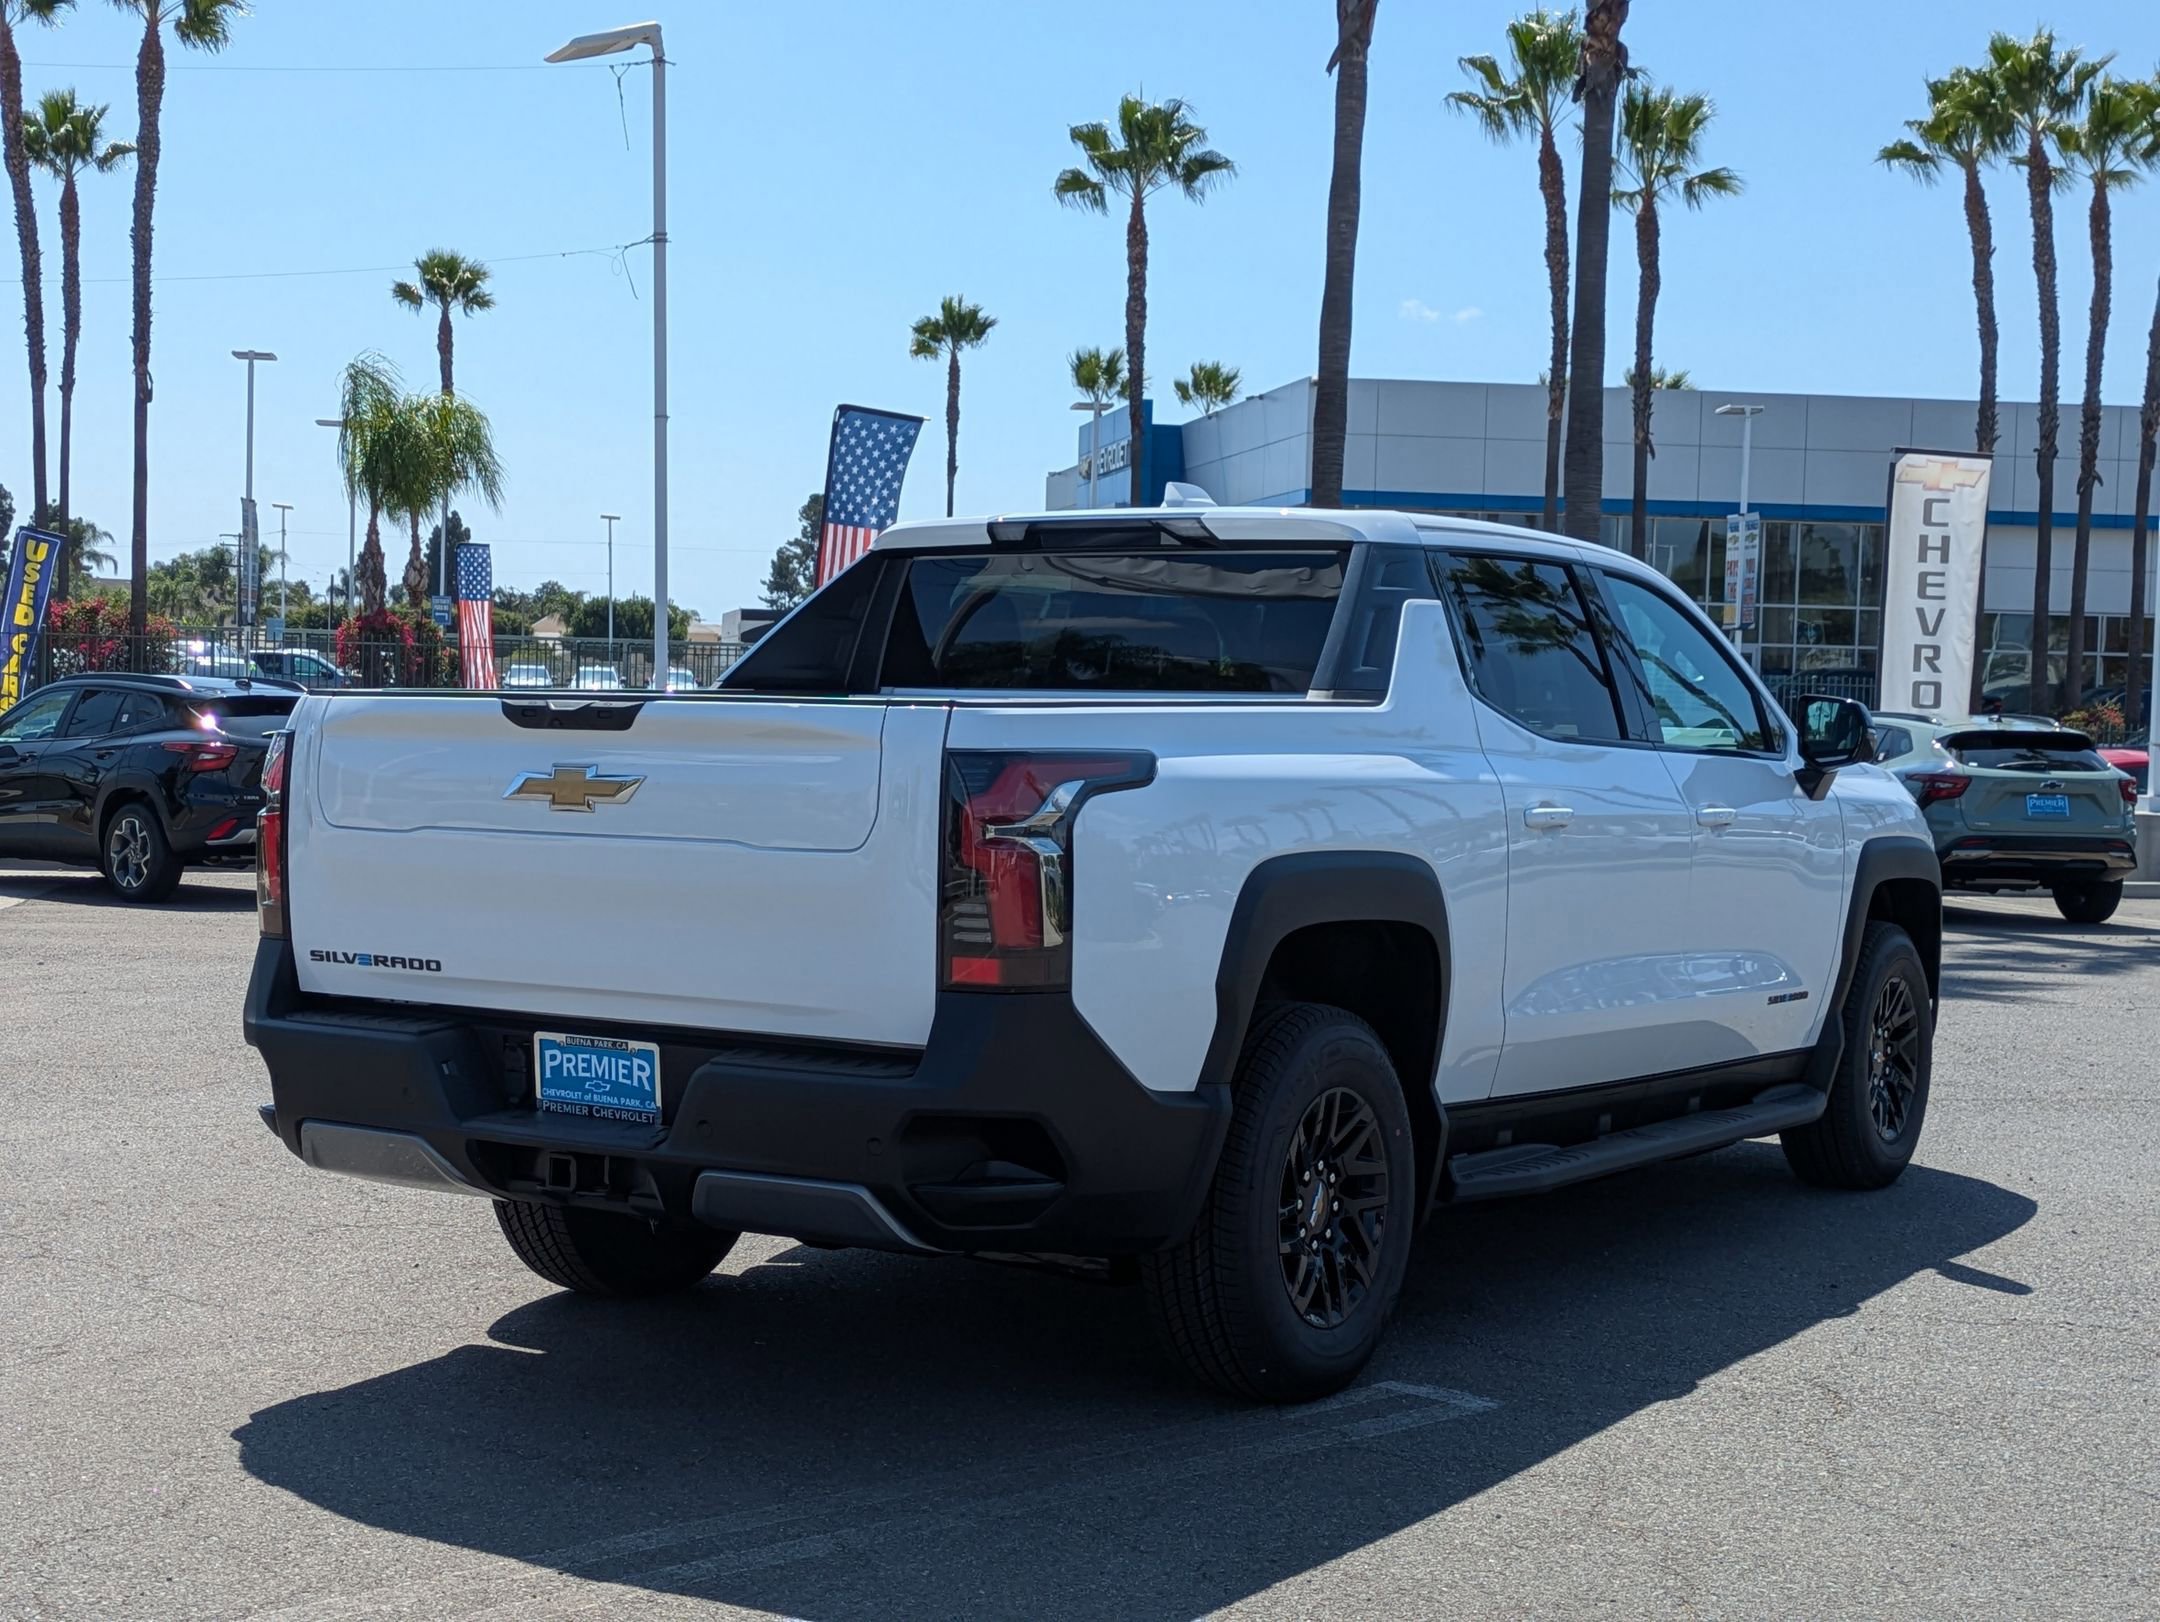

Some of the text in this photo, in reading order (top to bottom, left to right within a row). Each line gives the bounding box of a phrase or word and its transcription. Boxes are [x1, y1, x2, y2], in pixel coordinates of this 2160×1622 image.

[14, 539, 49, 626] USED
[2030, 798, 2065, 807] PREMIER
[310, 950, 442, 972] SILVERADO
[566, 1036, 592, 1047] BUENA
[544, 1048, 652, 1091] PREMIER
[543, 1087, 583, 1100] CHEVROLET
[584, 1092, 592, 1101] of
[593, 1093, 619, 1105] BUENA
[645, 1100, 657, 1109] CA
[543, 1100, 655, 1123] PREMIER CHEVROLET
